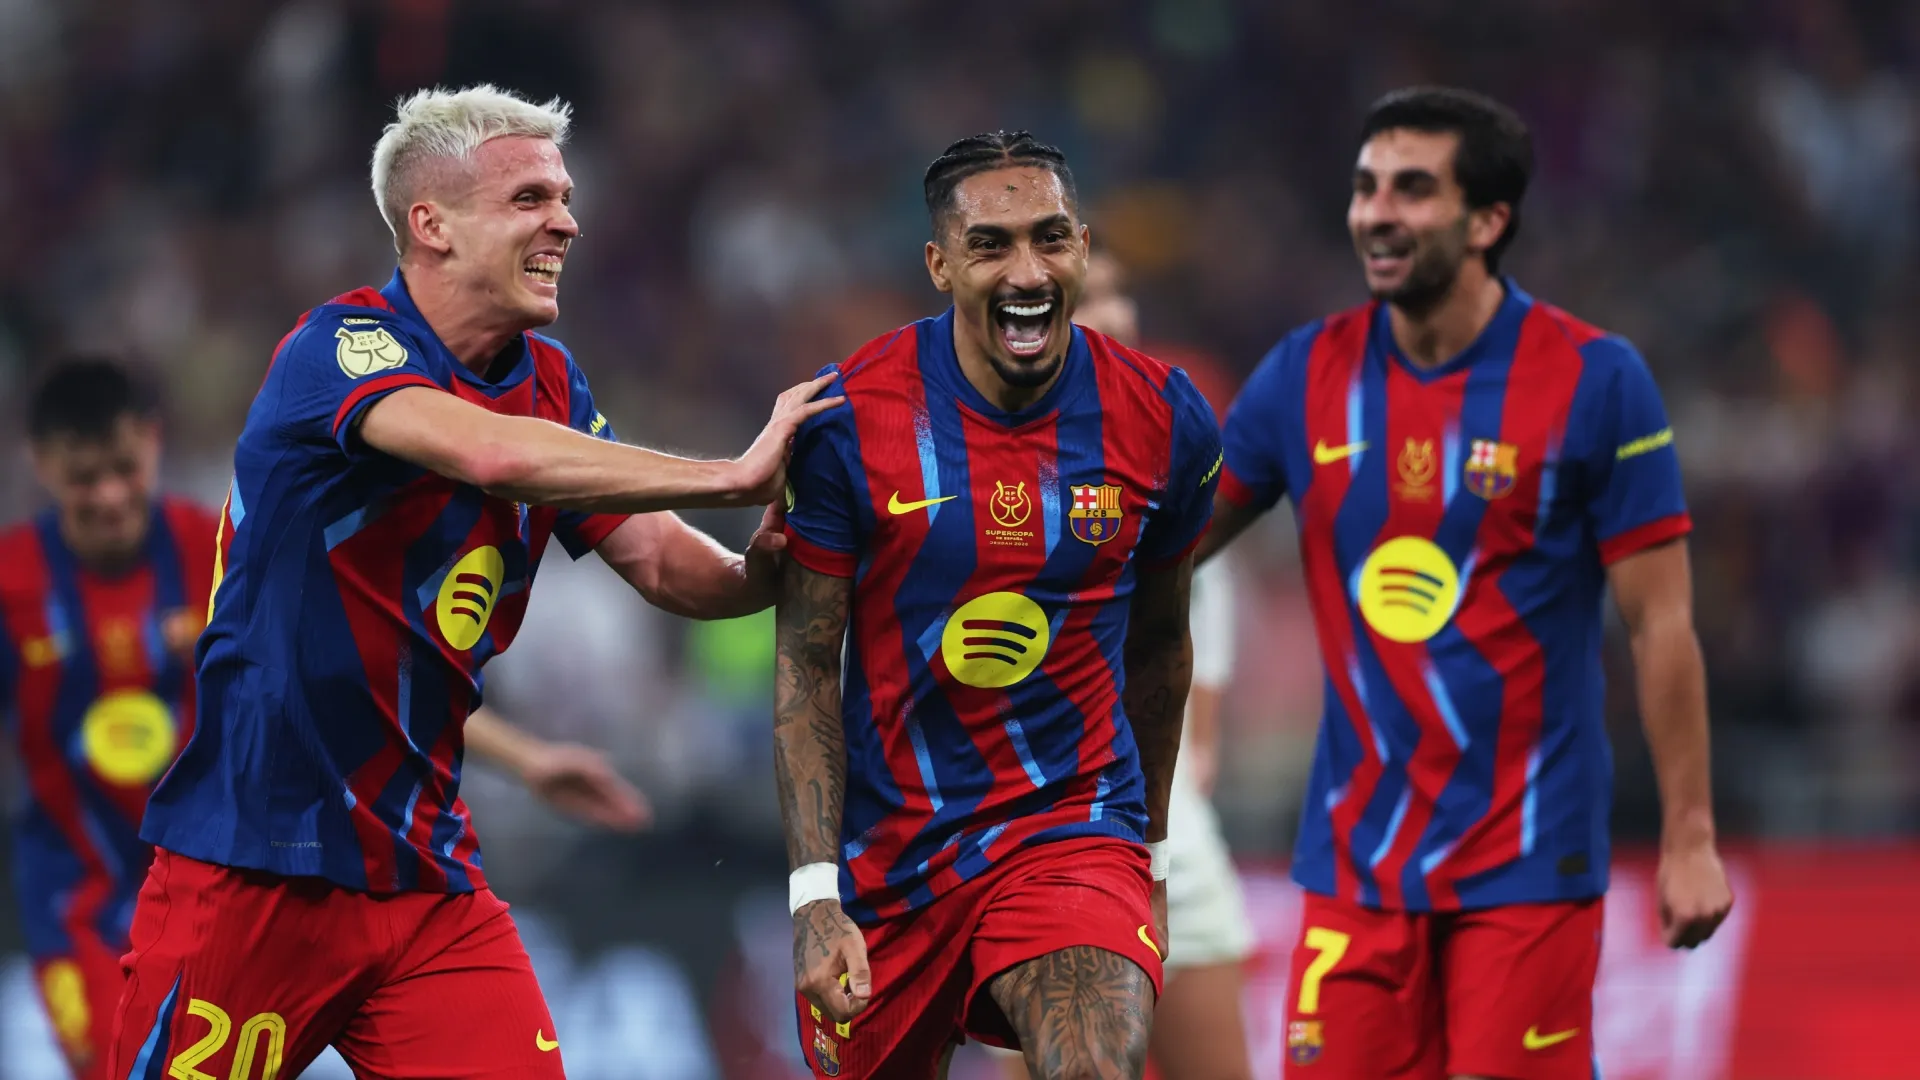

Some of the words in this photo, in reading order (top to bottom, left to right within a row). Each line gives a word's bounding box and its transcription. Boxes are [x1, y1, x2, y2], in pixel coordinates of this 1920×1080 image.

[985, 529, 1034, 537] SUPERCOPA
[1085, 509, 1107, 518] FCB
[1297, 926, 1351, 1014] 7
[168, 998, 287, 1080] 20
